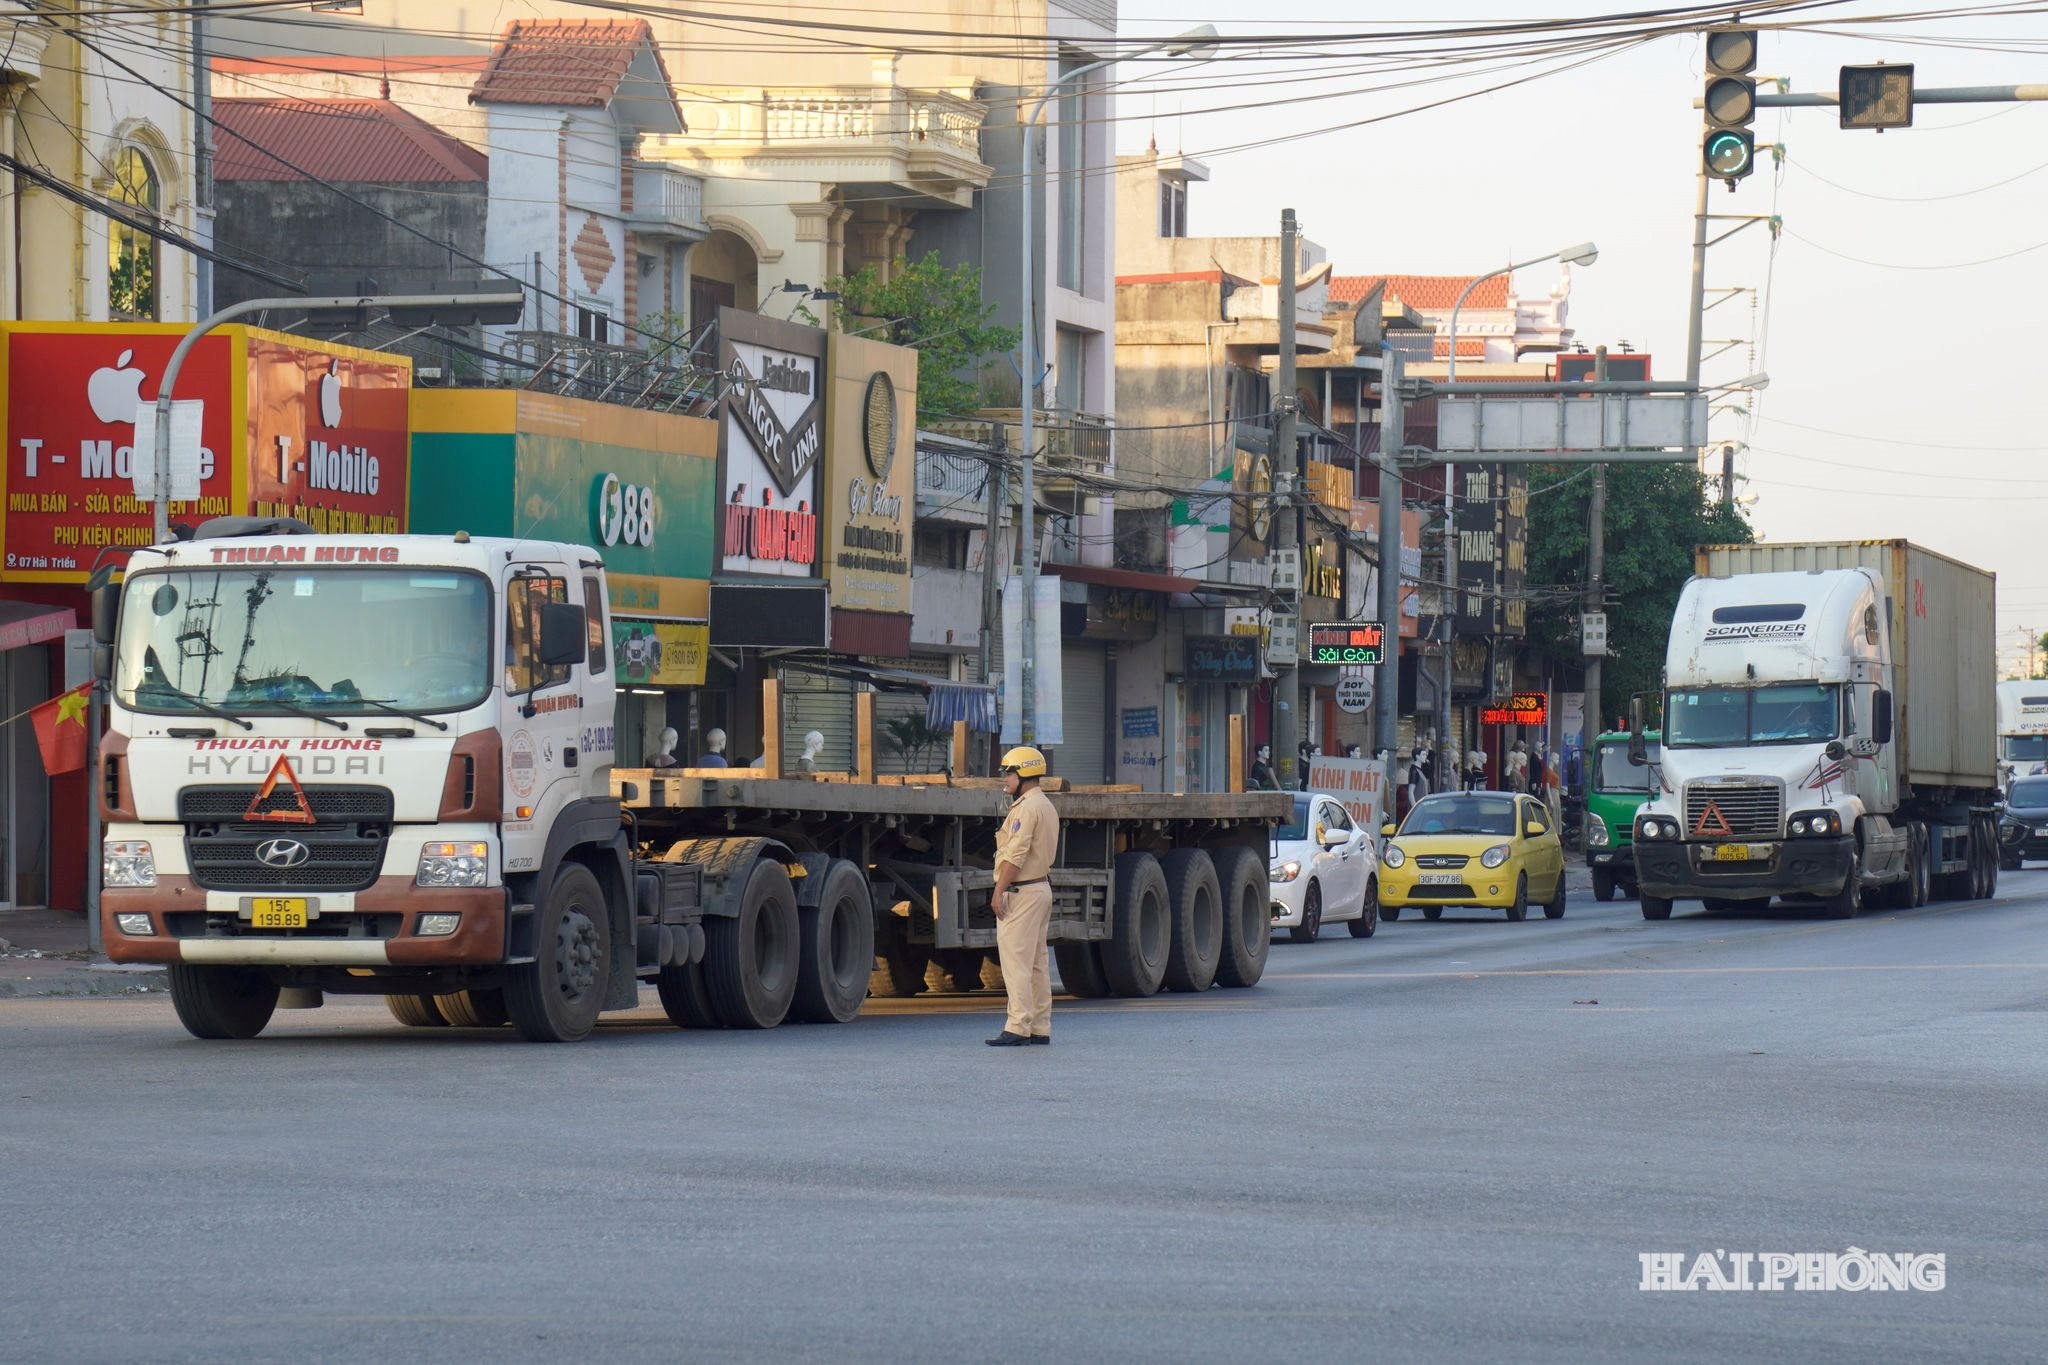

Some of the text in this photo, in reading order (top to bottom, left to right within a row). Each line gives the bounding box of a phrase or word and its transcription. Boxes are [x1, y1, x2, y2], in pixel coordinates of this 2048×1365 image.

[748, 387, 819, 478] NGỌC LINH
[20, 438, 44, 477] T
[81, 439, 215, 480] Moe
[278, 434, 293, 485] T
[310, 440, 380, 496] Mobile
[1466, 463, 1490, 504] THỜI
[10, 493, 38, 513] MUA
[41, 489, 68, 513] BÁN
[85, 487, 111, 514] SỬA
[750, 487, 787, 561] QUẢNG
[787, 500, 817, 564] CHÂU
[54, 523, 153, 549] PHỤ KIỆN CHÍNH
[210, 544, 400, 564] THUẬN HƯNG
[1460, 530, 1494, 562] TRANG
[19, 556, 32, 568] 07
[1312, 627, 1348, 646] KÍNH
[1706, 623, 1807, 636] SCHNEIDER
[1318, 647, 1376, 662] Sài Gòn
[1344, 681, 1364, 689] BOY
[1342, 698, 1366, 707] NAM
[195, 736, 385, 753] THUẬN HƯNG
[1311, 763, 1381, 793] KÍNH MẮT
[1420, 874, 1461, 884] 30F-377.86
[269, 900, 290, 913] 15C
[259, 913, 301, 926] 199.89
